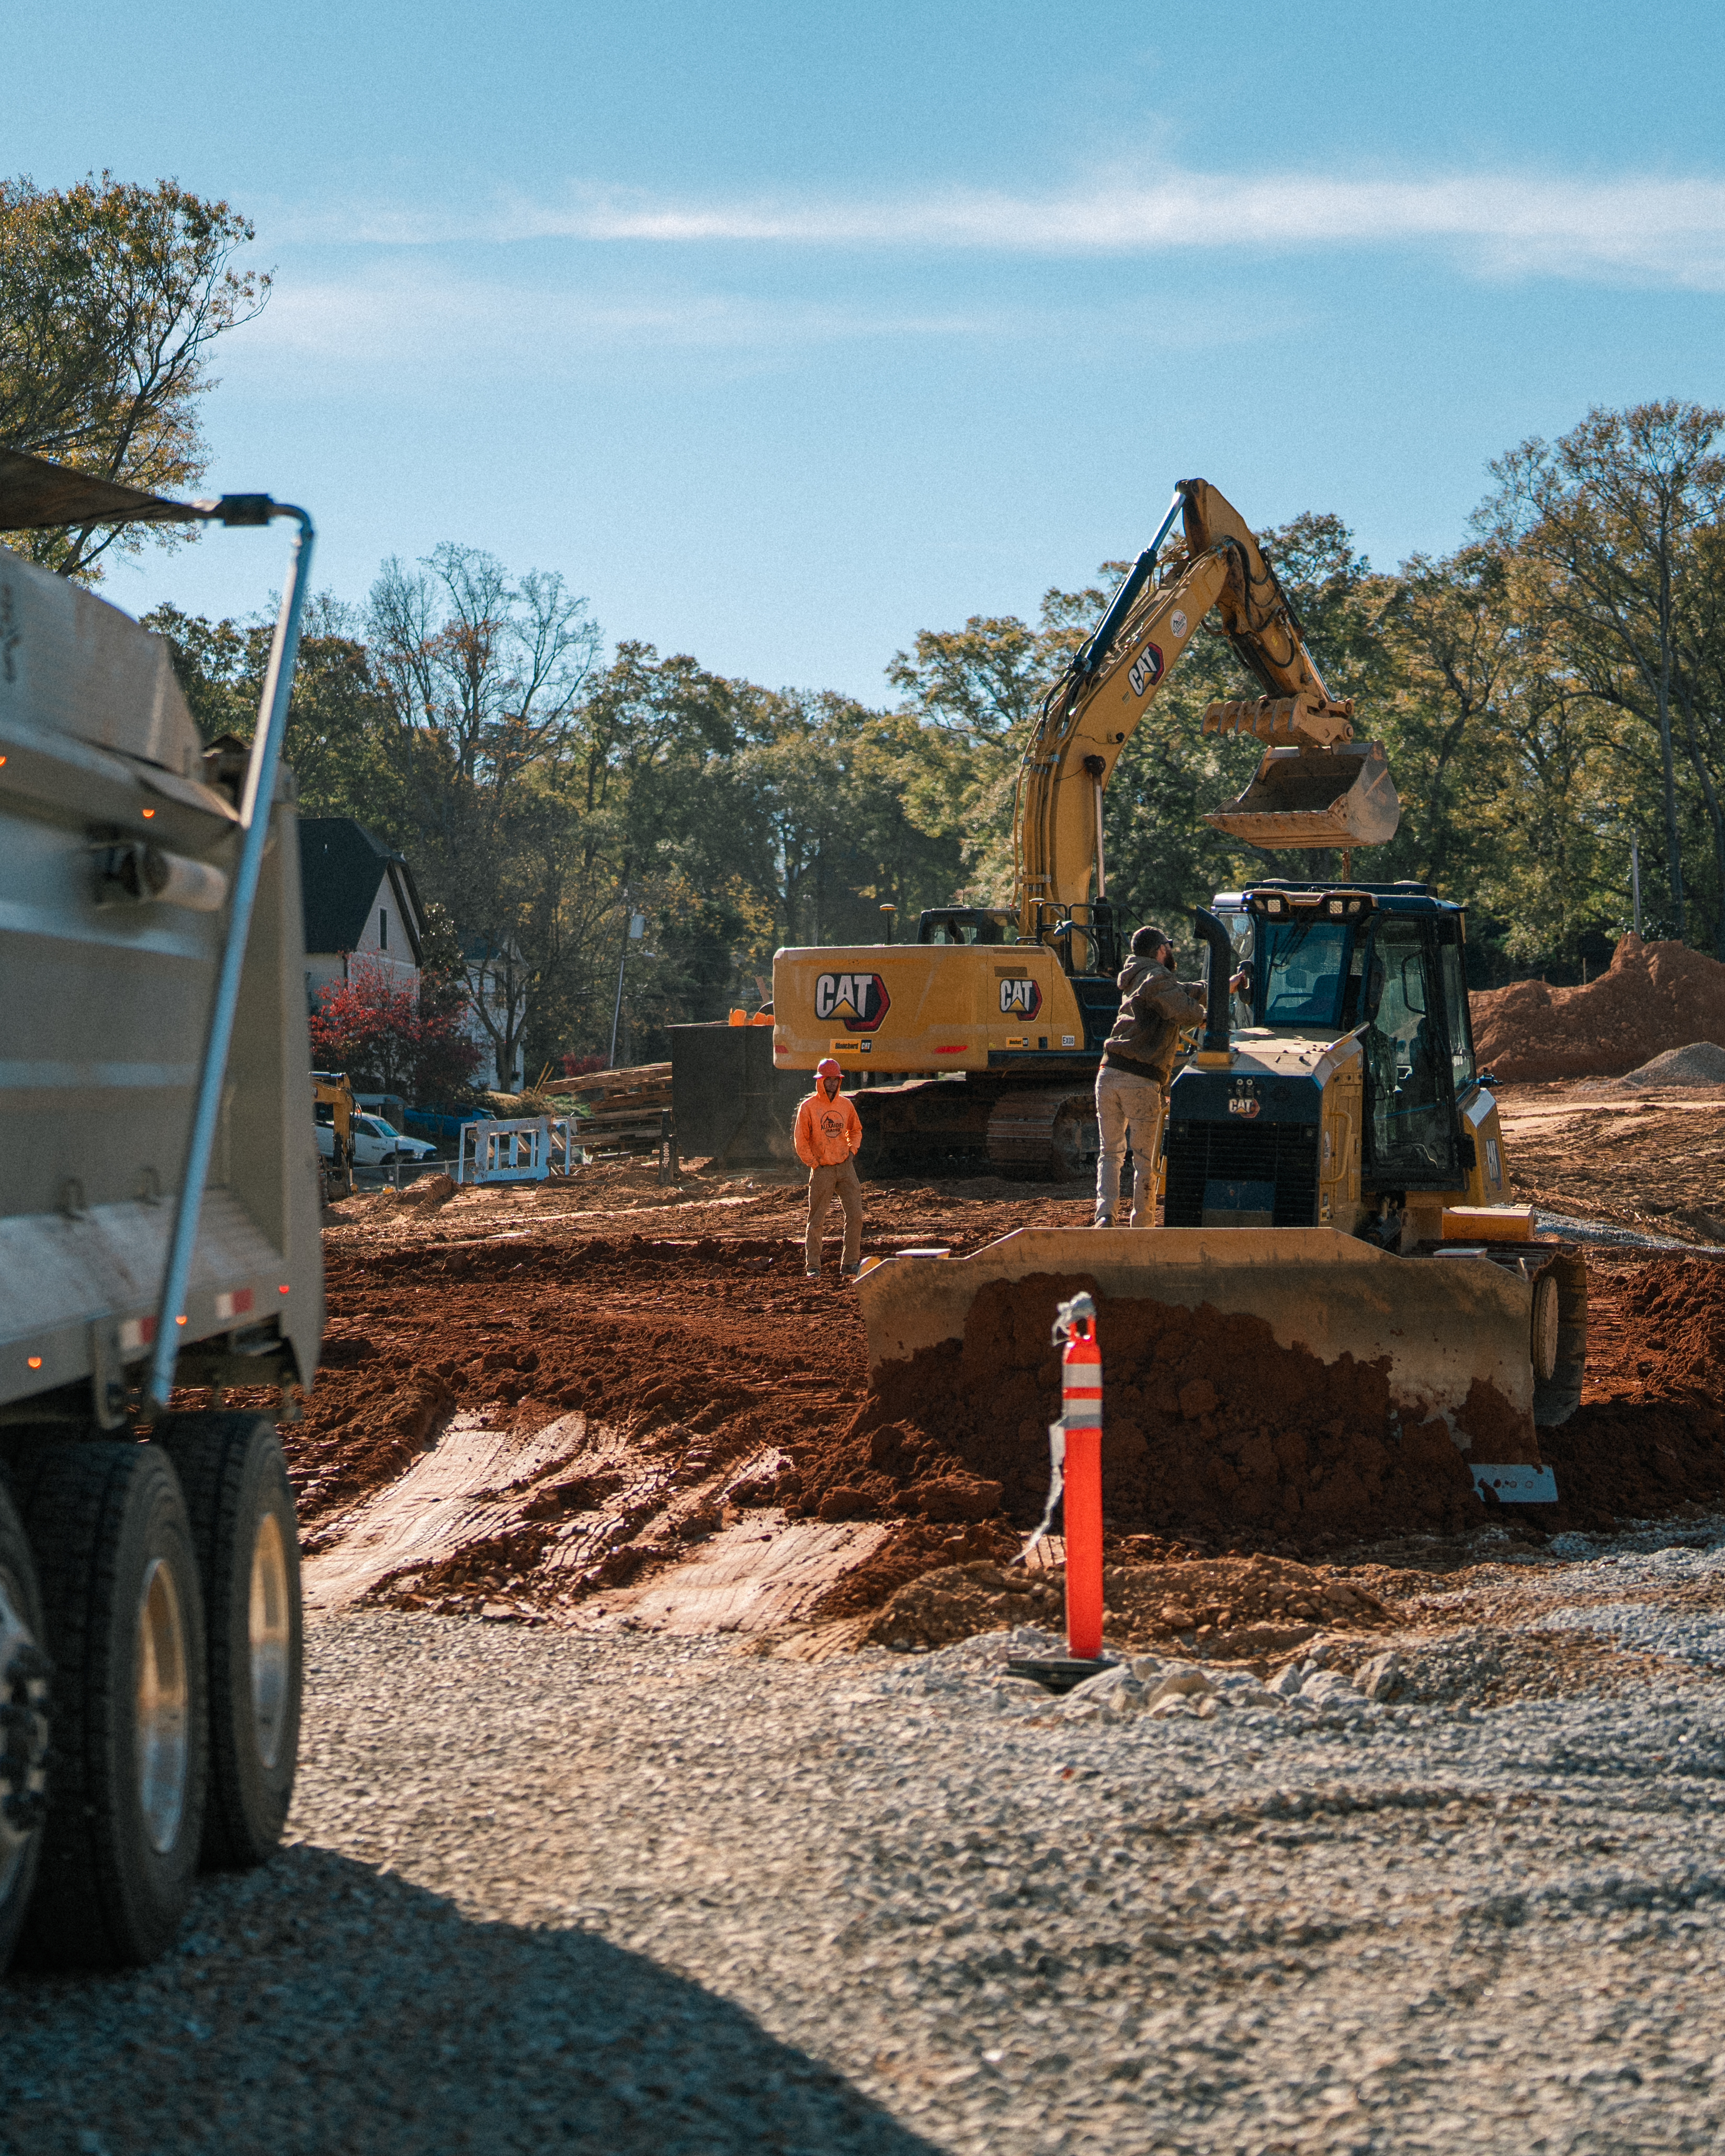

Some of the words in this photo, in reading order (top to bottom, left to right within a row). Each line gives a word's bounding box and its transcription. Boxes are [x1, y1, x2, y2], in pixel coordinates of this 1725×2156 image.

[1129, 646, 1157, 695] CAT
[817, 975, 872, 1018] CAT
[1001, 980, 1032, 1011] CAT
[1229, 1099, 1252, 1113] CAT
[1486, 1140, 1499, 1180] CAT
